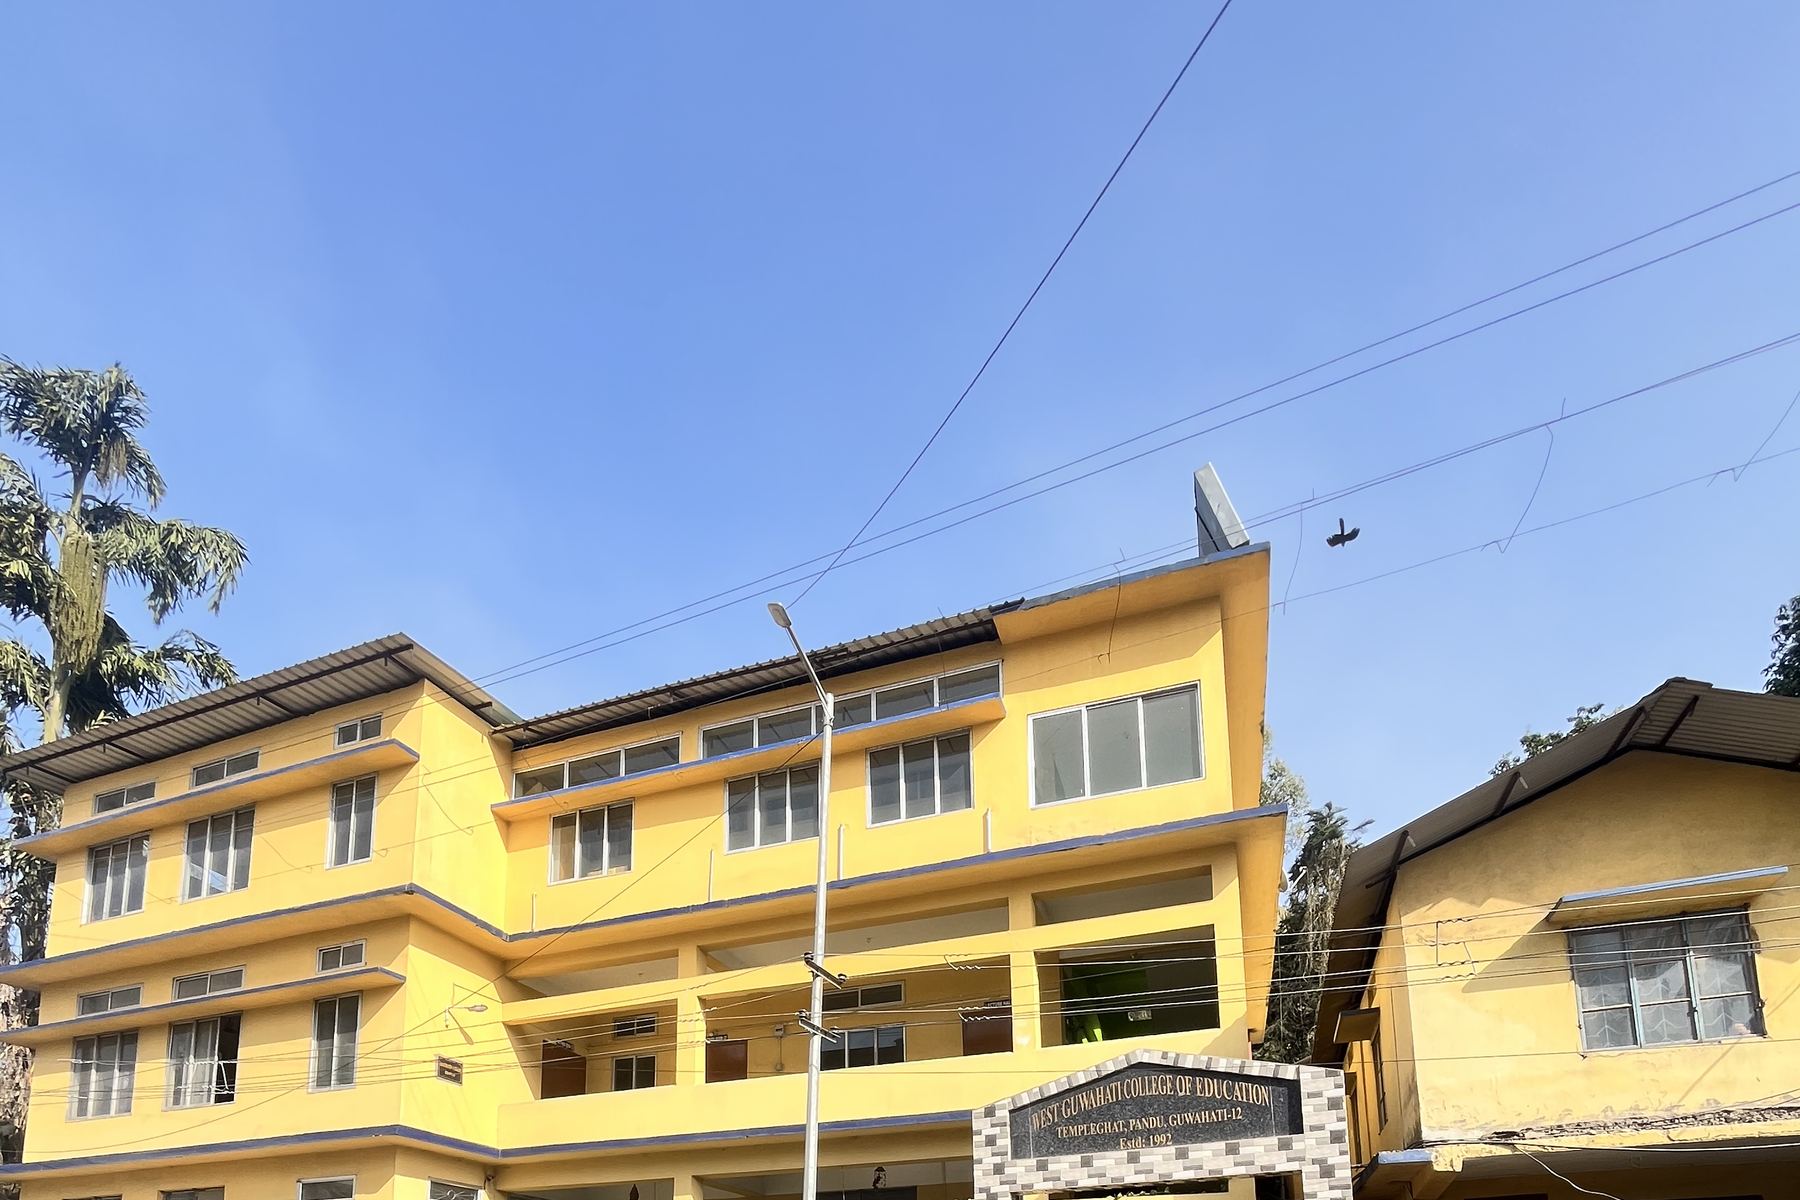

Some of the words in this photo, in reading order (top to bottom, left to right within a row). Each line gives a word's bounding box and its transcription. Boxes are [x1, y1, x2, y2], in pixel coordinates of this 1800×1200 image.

[1031, 1102, 1060, 1132] WEST
[1062, 1081, 1122, 1118] GUWAHATI
[1123, 1075, 1174, 1099] COLLEGE
[1176, 1075, 1193, 1096] OF
[1196, 1076, 1270, 1107] EDUCATION
[1169, 1106, 1243, 1127] GUWAHATI-12
[1120, 1137, 1146, 1150] Estd:
[1149, 1134, 1173, 1147] 1992
